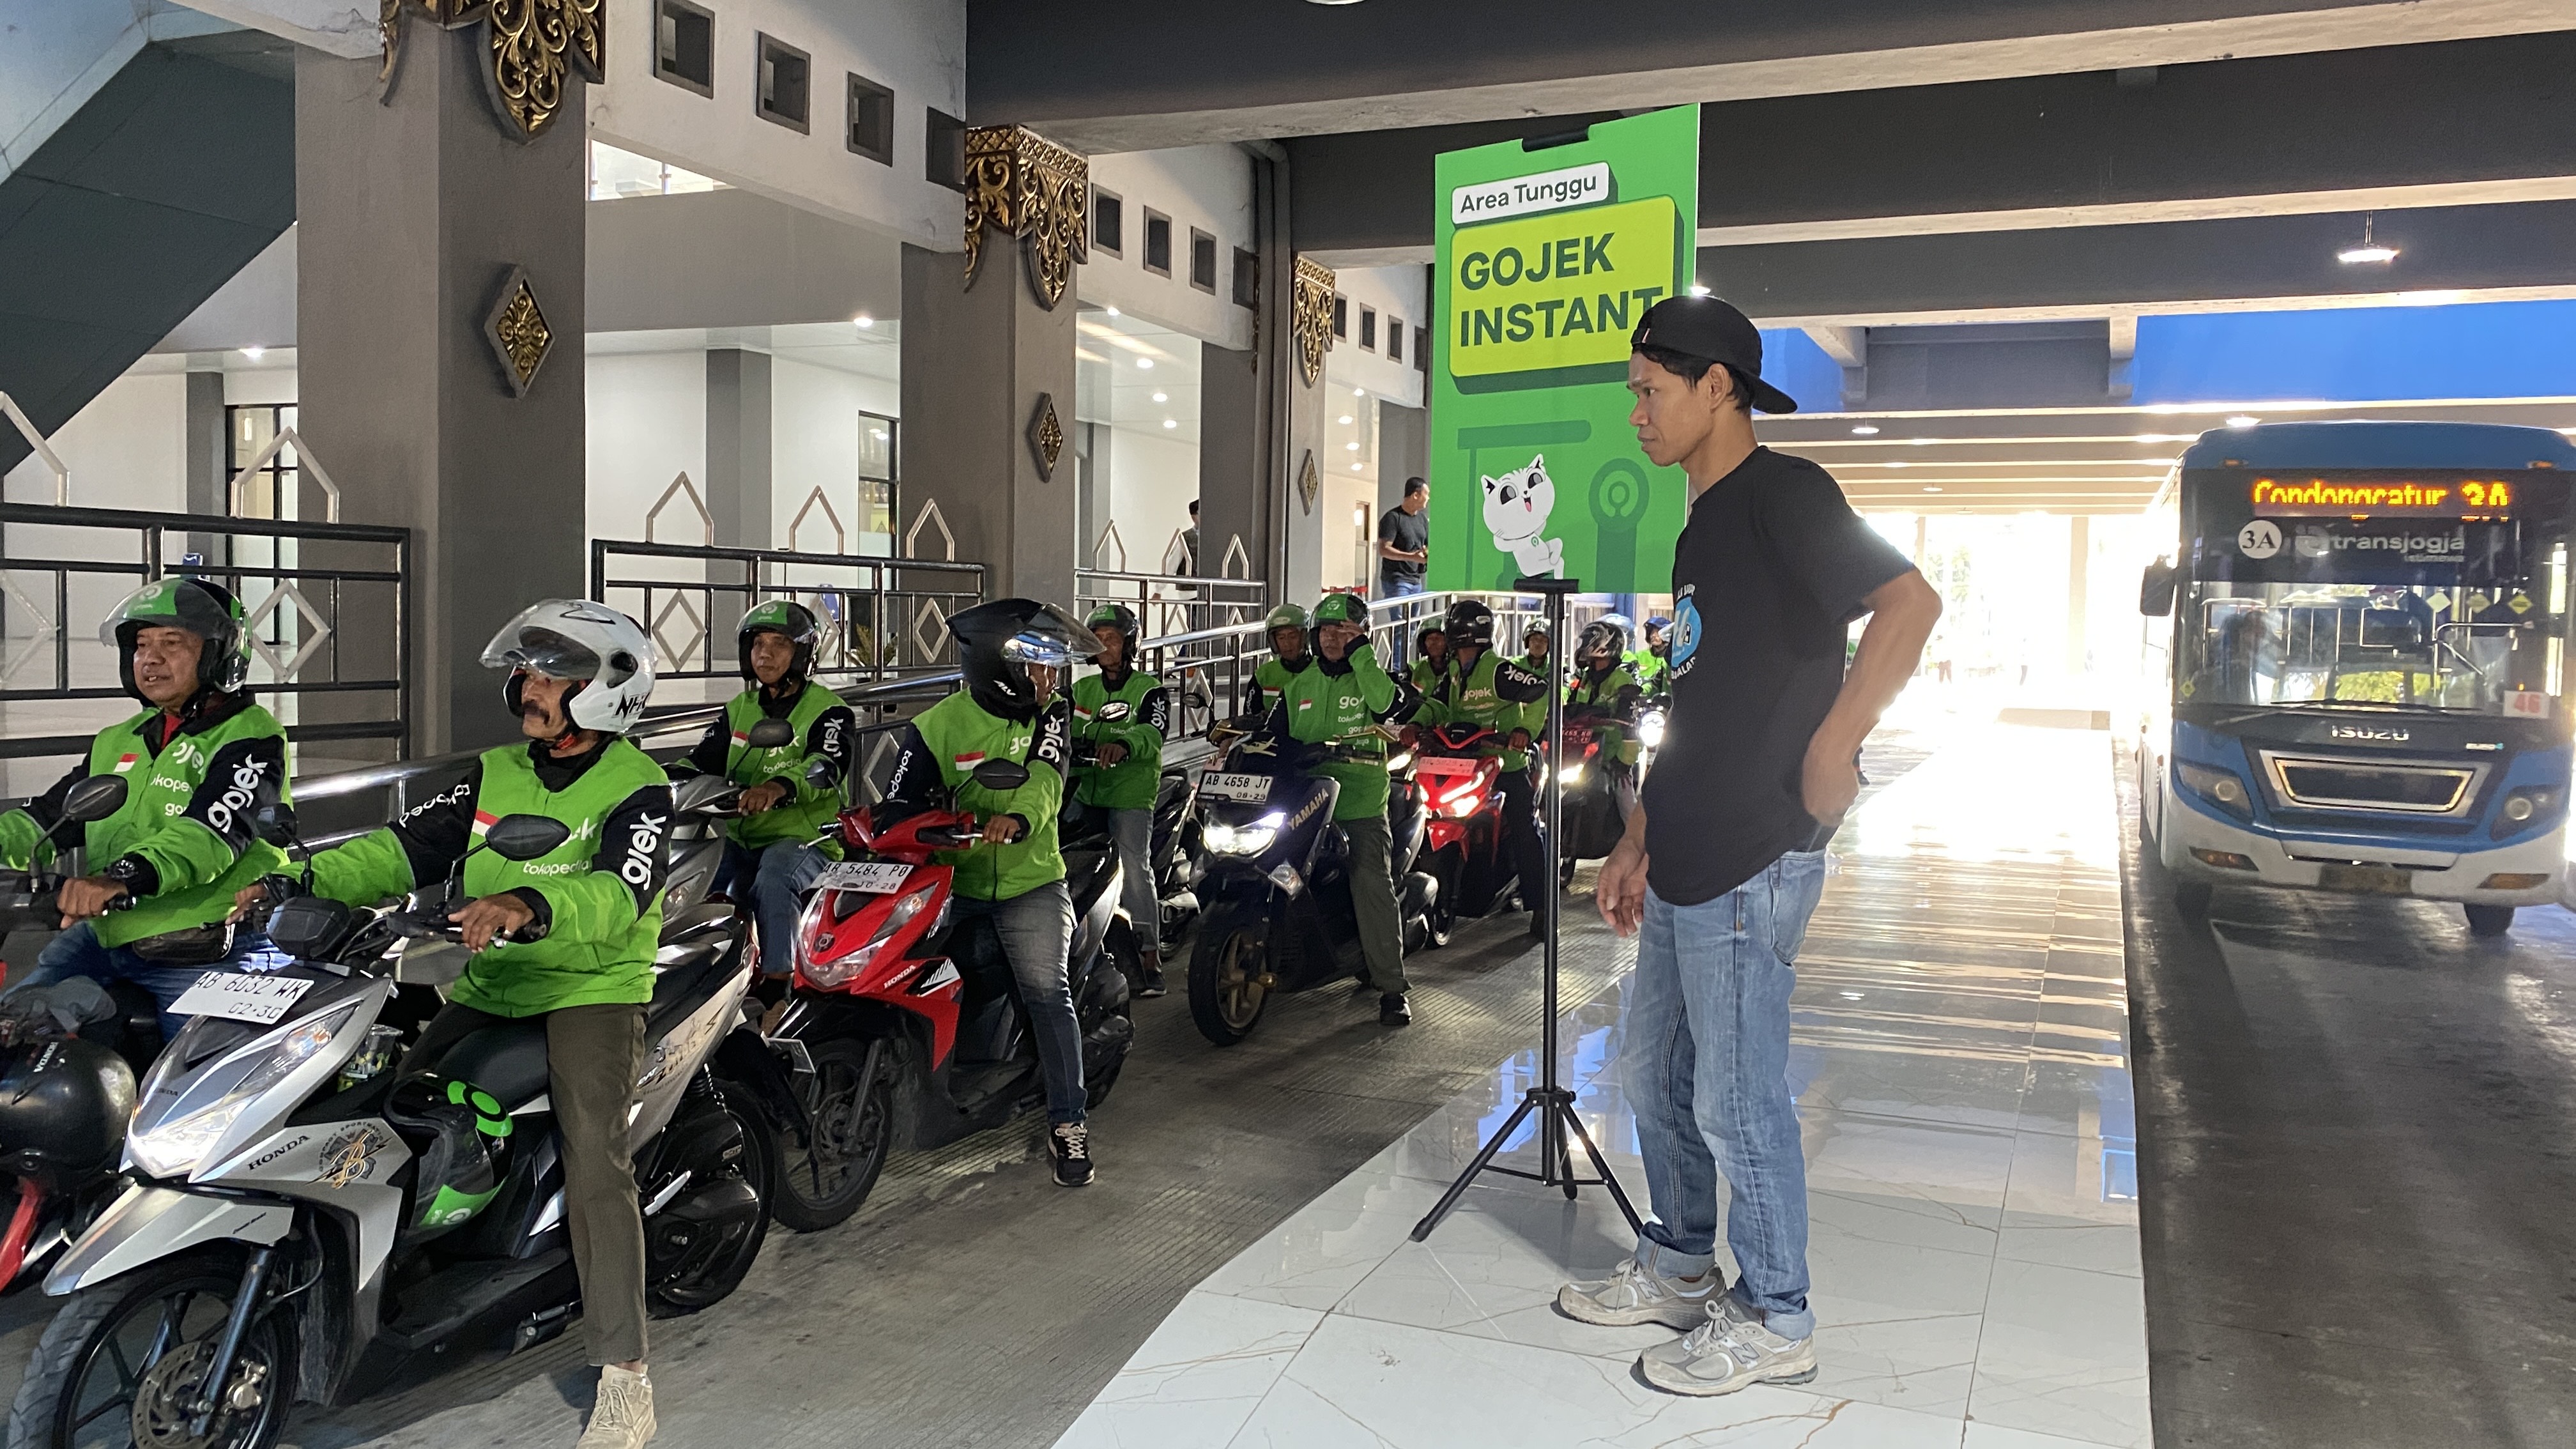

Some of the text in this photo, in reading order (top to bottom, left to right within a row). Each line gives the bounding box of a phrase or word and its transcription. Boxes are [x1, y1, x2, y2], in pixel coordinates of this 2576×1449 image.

[1460, 176, 1597, 213] Area Tunggu
[1460, 232, 1614, 290] GOJEK
[1460, 286, 1663, 347] INSTANT
[2242, 530, 2277, 549] 3A
[2334, 532, 2465, 554] transjogja
[2331, 725, 2409, 742] ISUZU
[208, 753, 268, 834] gojek
[1206, 775, 1271, 790] AB 4658 JT
[1287, 787, 1330, 831] YAMAHA
[523, 861, 589, 877] tokopedia
[845, 862, 883, 877] 5484
[192, 972, 311, 999] AB 6032 WK
[884, 964, 917, 989] HONDA
[247, 1135, 310, 1170] HONDA
